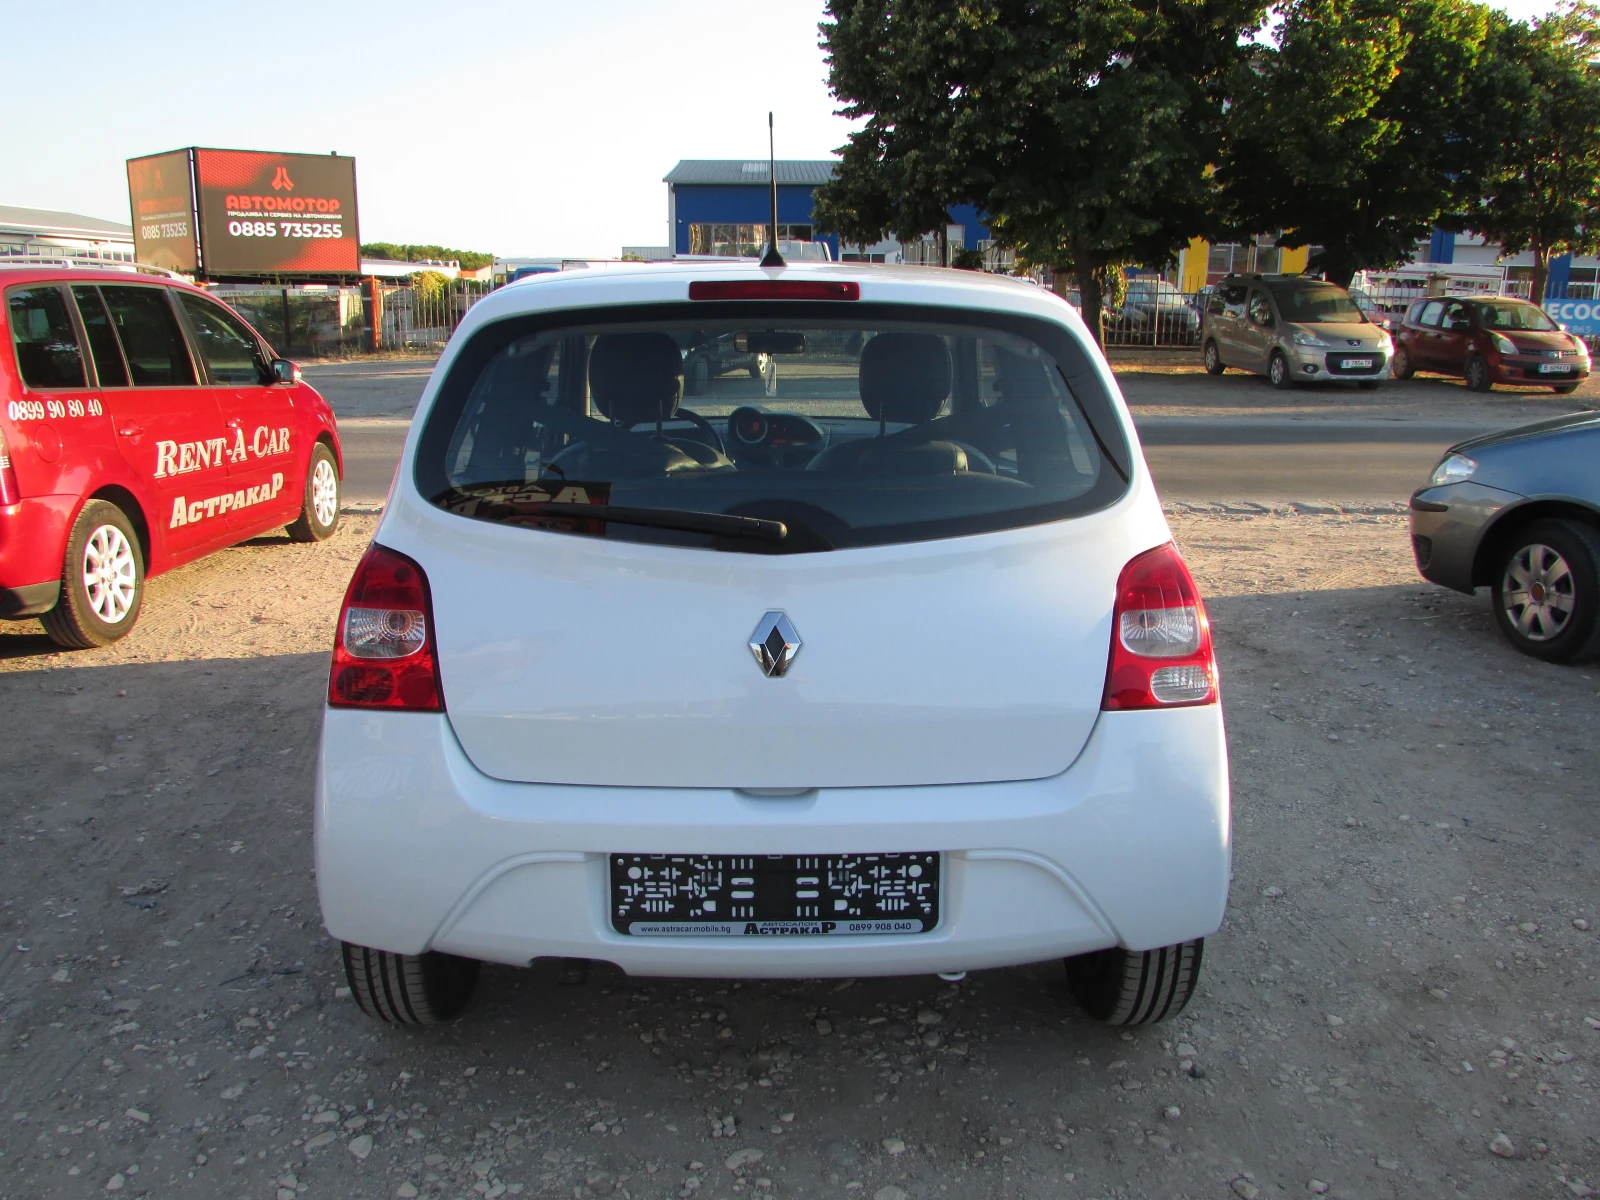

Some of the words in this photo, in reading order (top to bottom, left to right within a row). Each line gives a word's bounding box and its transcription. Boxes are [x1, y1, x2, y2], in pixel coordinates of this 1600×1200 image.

[225, 194, 340, 212] АВТОМОТОР
[227, 210, 263, 218] ПРОДАЖБА
[142, 224, 160, 239] 0885
[161, 221, 188, 238] 735255
[229, 221, 277, 237] 0885
[280, 222, 343, 238] 735255
[8, 400, 45, 421] 0899
[48, 400, 66, 419] 90
[68, 399, 85, 418] 80
[87, 398, 103, 416] 40
[640, 924, 731, 934] www.astracar.mobile.bg
[849, 923, 872, 931] 0899
[874, 923, 892, 931] 908
[894, 922, 912, 931] 040
